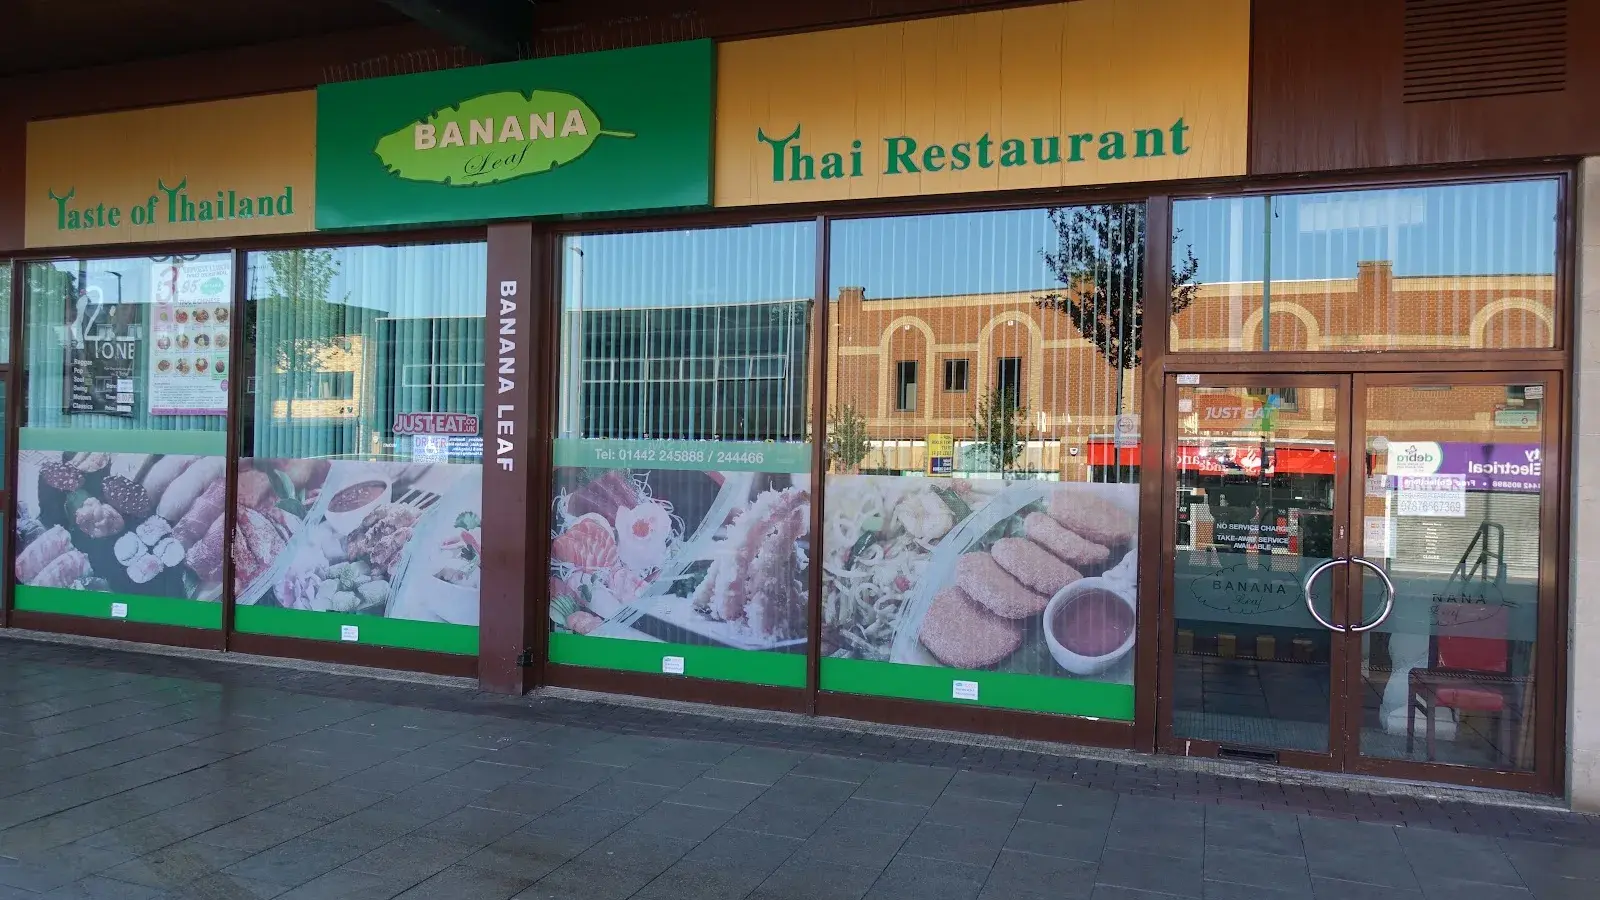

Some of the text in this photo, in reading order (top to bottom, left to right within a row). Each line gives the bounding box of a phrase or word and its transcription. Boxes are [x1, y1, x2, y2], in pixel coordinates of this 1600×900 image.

[414, 109, 588, 150] BANANA
[757, 116, 1191, 182] Thai Restaurant
[461, 142, 534, 179] Leaf
[48, 174, 295, 231] Taste of Thailand
[496, 280, 518, 472] BANANA LEAF
[1204, 406, 1241, 420] JUST
[394, 415, 467, 433] JUST EAT
[594, 448, 616, 461] Tel:
[618, 449, 656, 462] 01442
[658, 450, 704, 463] 245888
[717, 451, 764, 464] 244466
[1228, 523, 1260, 531] SERVICE
[1233, 542, 1272, 550] AVAILABLE
[1258, 536, 1289, 544] SERVICE
[1212, 580, 1286, 594] BANANA
